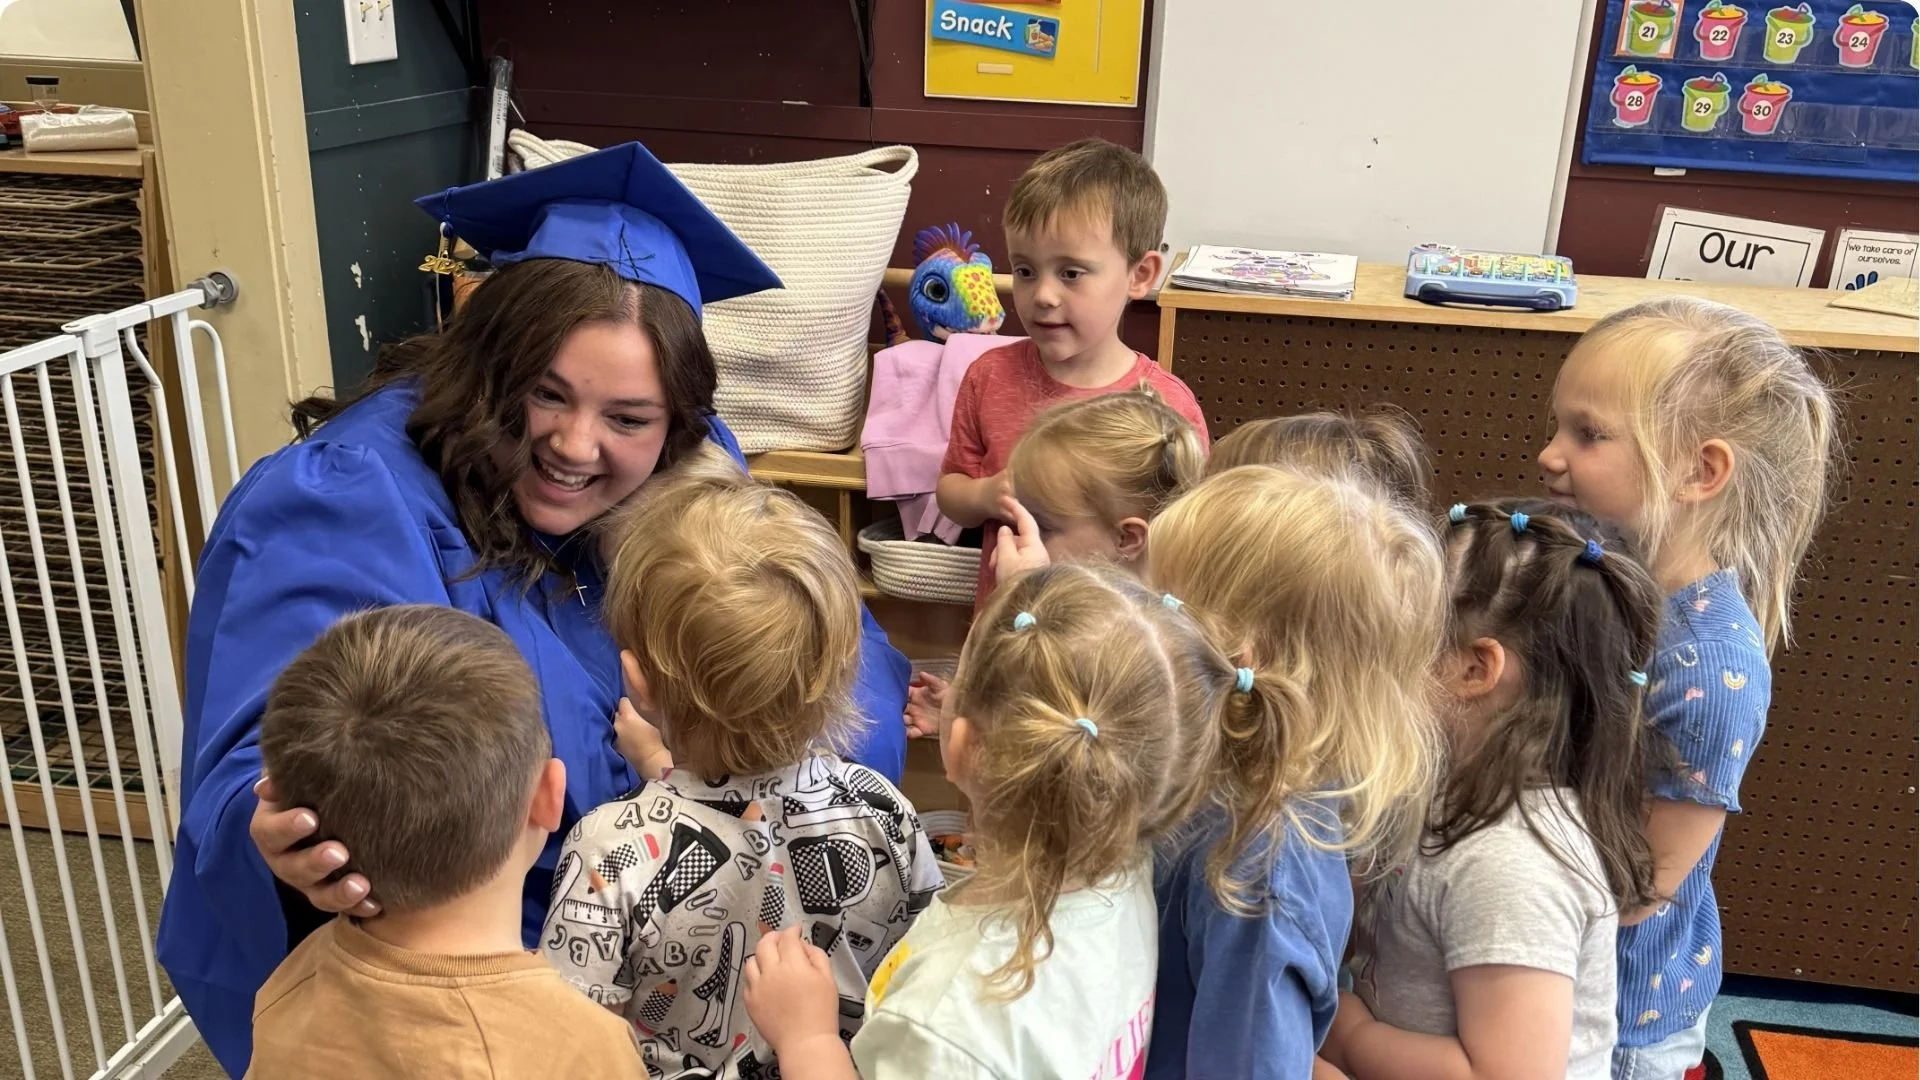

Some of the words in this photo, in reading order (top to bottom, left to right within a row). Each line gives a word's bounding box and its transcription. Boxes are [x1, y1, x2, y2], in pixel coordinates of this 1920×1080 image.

[940, 9, 1013, 41] Snack
[1641, 25, 1656, 38] 21
[1711, 29, 1728, 42] 22
[1777, 32, 1794, 44] 23
[1851, 36, 1868, 48] 24
[1627, 95, 1643, 107] 28
[1694, 102, 1711, 114] 29
[1753, 104, 1771, 116] 30
[1699, 232, 1775, 270] Our
[1863, 245, 1881, 253] take
[1882, 247, 1903, 255] care
[1904, 248, 1915, 256] of
